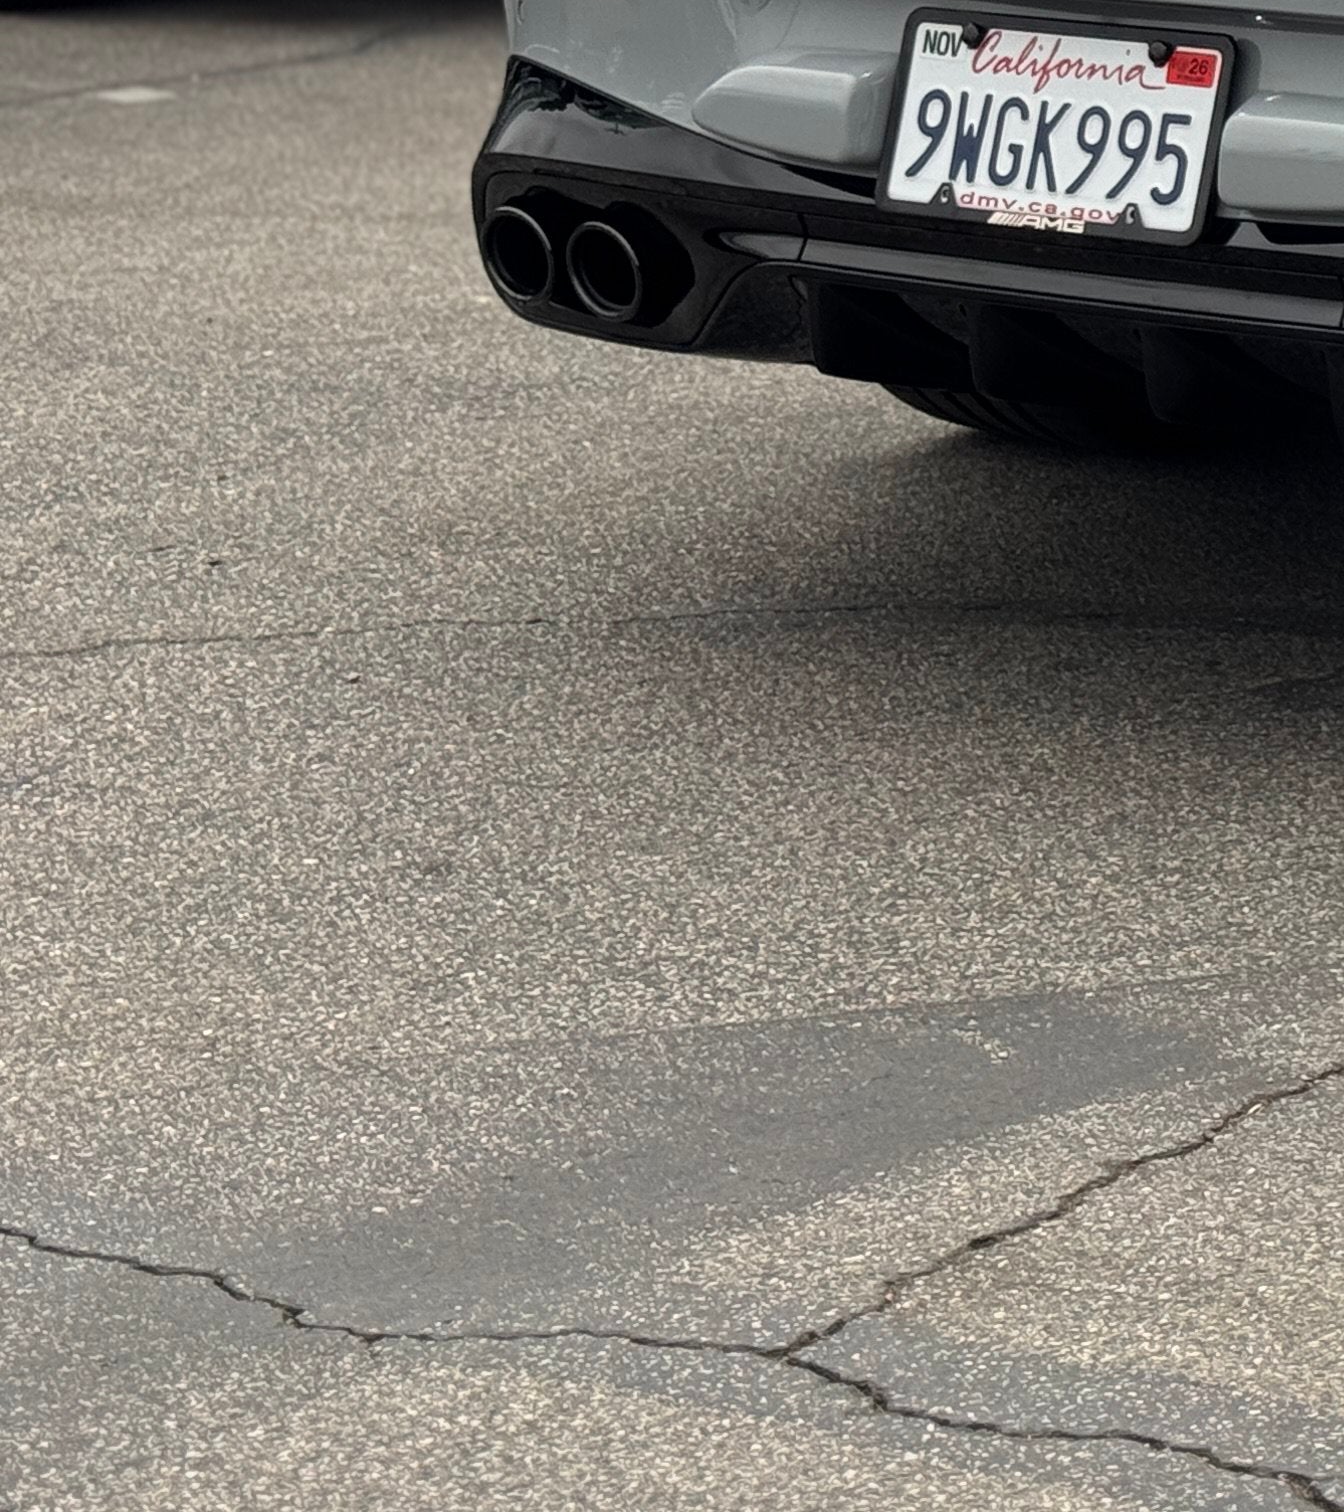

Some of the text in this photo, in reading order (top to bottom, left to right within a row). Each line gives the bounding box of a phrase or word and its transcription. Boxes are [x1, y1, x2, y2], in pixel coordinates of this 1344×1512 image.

[922, 29, 963, 57] NOV
[972, 30, 1165, 94] California
[1187, 57, 1209, 76] 26
[904, 88, 1192, 206] 9WGK995
[959, 191, 1121, 222] dmv.ca.gov
[1016, 212, 1085, 234] AMG
